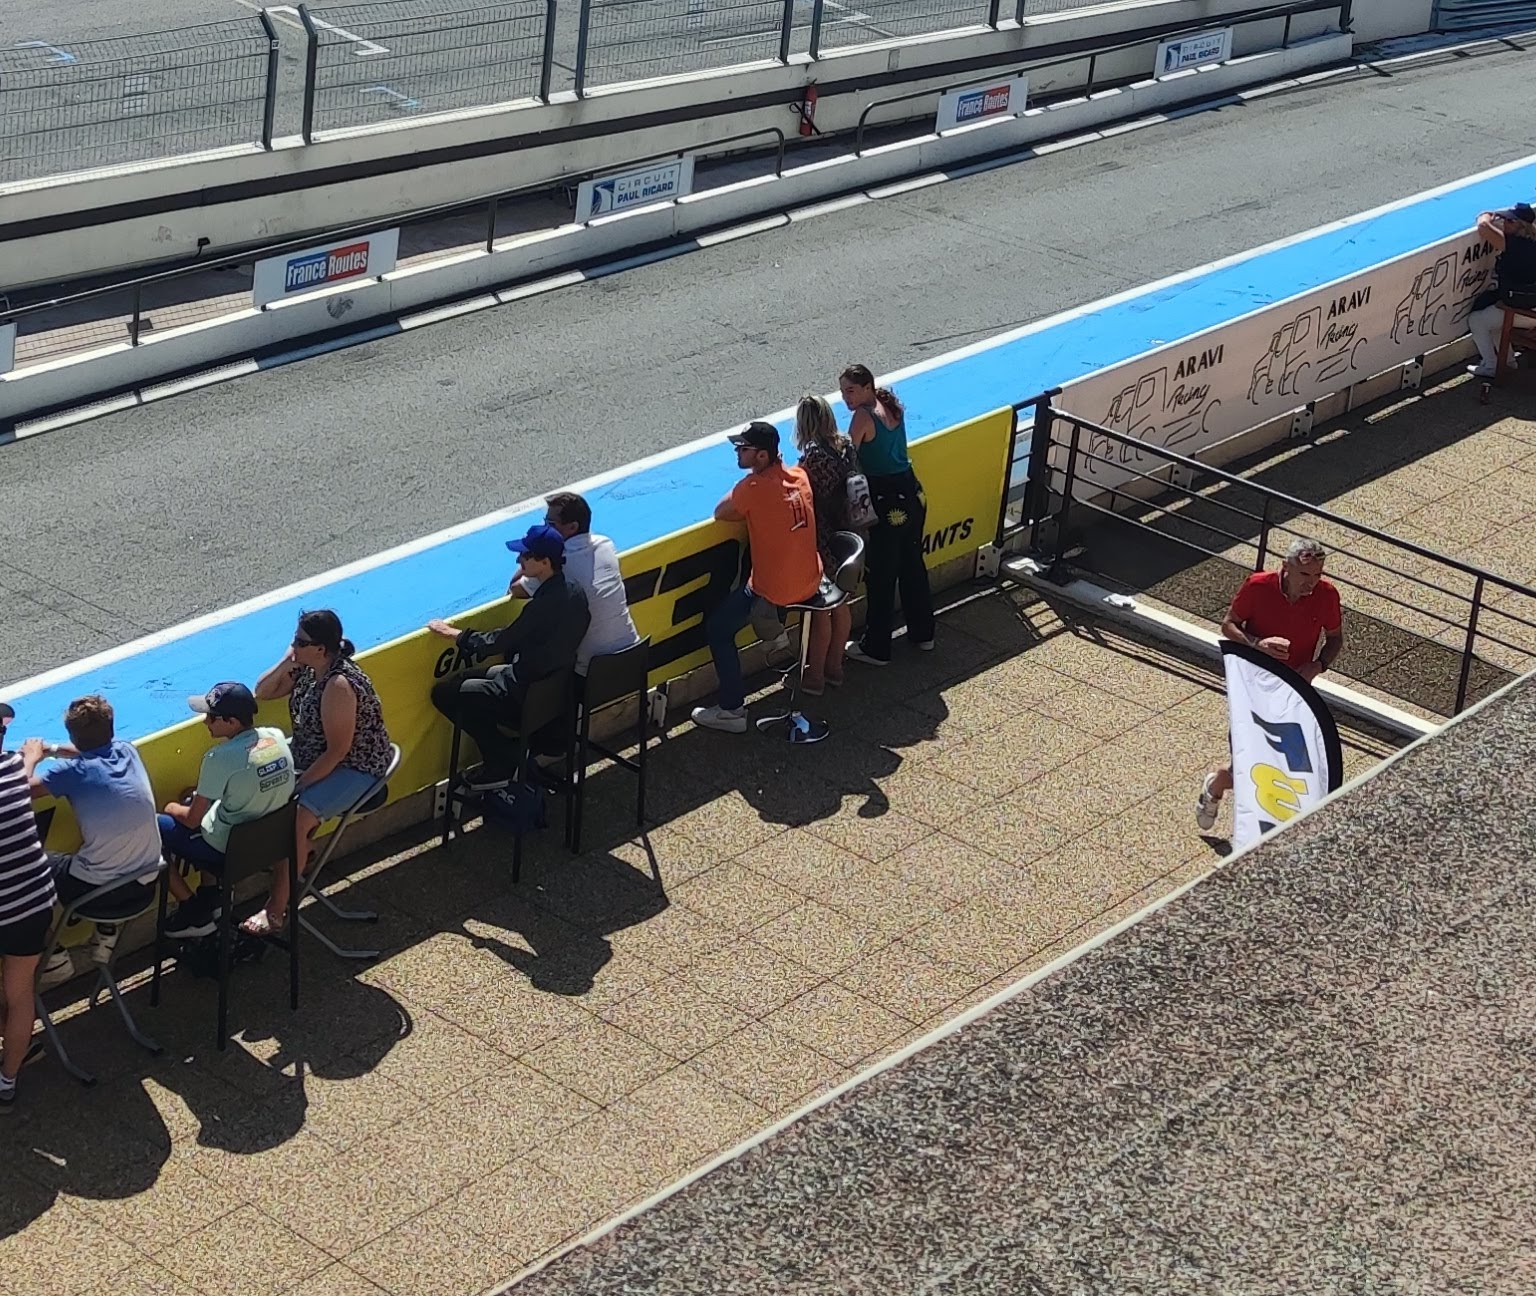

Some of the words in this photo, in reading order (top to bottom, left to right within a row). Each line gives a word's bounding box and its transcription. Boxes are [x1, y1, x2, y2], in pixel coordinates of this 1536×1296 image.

[617, 190, 640, 203] PAUL
[642, 181, 673, 200] RICARD
[618, 170, 675, 191] CIRCUIT
[287, 262, 326, 286] France
[328, 251, 367, 277] Routes
[1326, 286, 1371, 321] ARAVI
[1173, 344, 1224, 381] ARAVI
